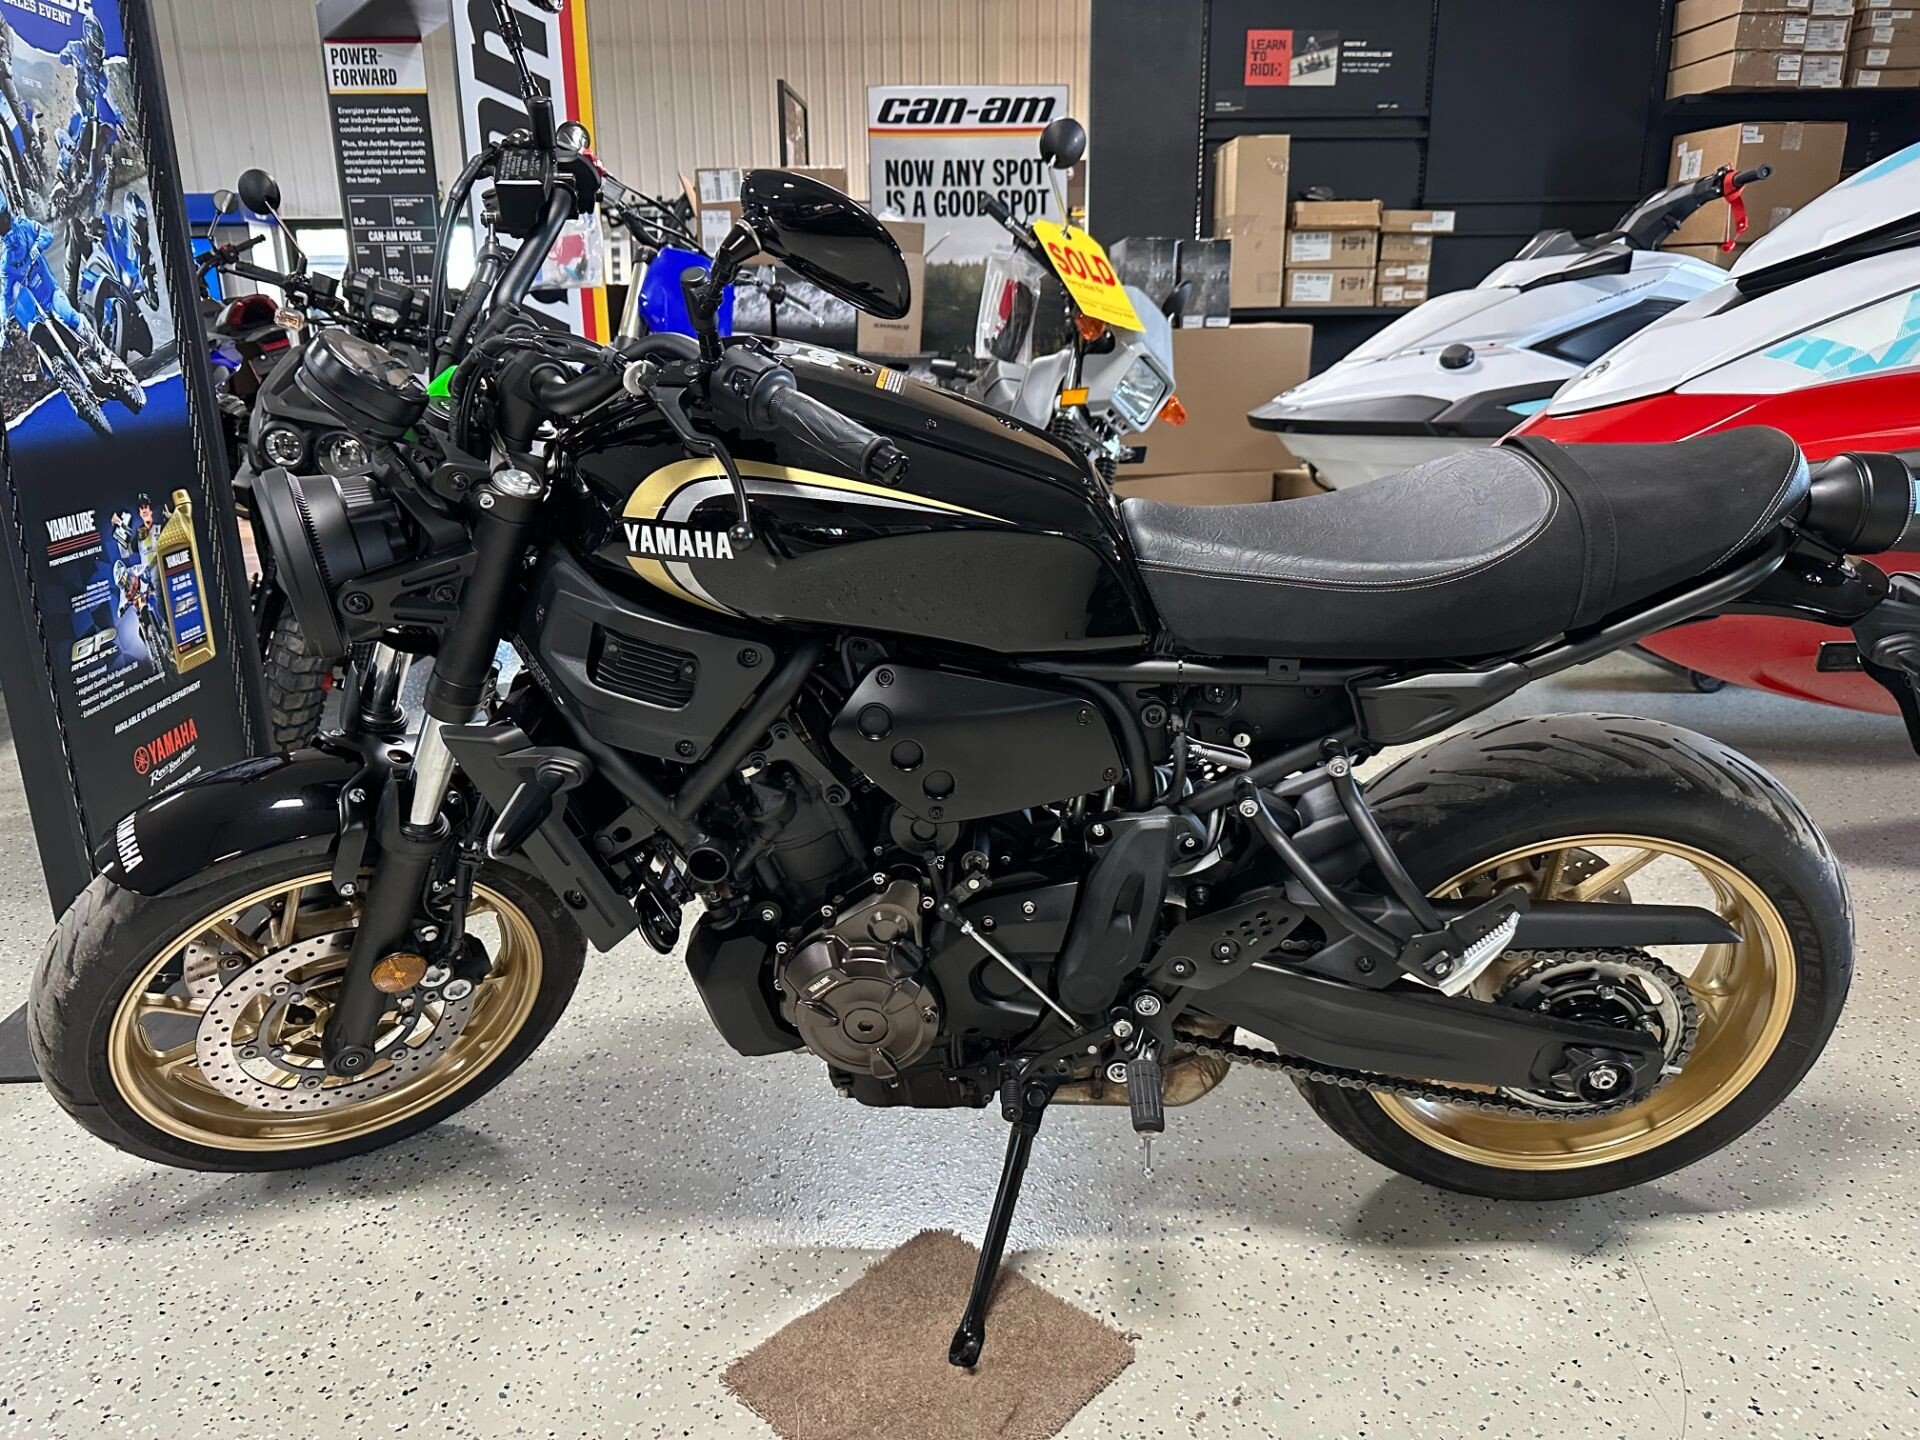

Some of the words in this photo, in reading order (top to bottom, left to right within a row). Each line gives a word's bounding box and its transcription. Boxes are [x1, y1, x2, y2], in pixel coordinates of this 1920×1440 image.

[38, 2, 72, 26] EVENT
[1251, 39, 1287, 50] LEARN
[330, 47, 383, 65] POWER-
[1251, 51, 1267, 62] TO
[332, 68, 397, 86] FORWARD
[1250, 62, 1282, 77] RIDE
[337, 106, 365, 115] Energize
[365, 107, 379, 115] your
[380, 106, 397, 114] rides
[397, 106, 412, 114] with
[877, 96, 1056, 124] can-am
[339, 125, 361, 133] cooled
[362, 125, 386, 134] charger
[387, 125, 399, 133] and
[342, 149, 365, 157] greater
[365, 148, 388, 156] control
[388, 148, 401, 156] and
[402, 148, 426, 156] smooth
[357, 139, 369, 147] the
[369, 139, 389, 147] Active
[410, 139, 425, 148] puts
[343, 157, 382, 165] deceleration
[404, 157, 424, 165] hands
[362, 167, 382, 175] giving
[398, 167, 418, 175] power
[885, 159, 934, 187] NOW
[942, 158, 985, 187] ANY
[993, 158, 1044, 186] SPOT
[886, 189, 905, 217] IS
[912, 190, 927, 217] A
[934, 189, 991, 218] GOOD
[997, 189, 1050, 216] SPOT
[368, 231, 398, 241] CAN-AM
[399, 230, 423, 241] PULSE
[1047, 242, 1116, 287] SOLD
[46, 510, 96, 542] YAMALUBE
[623, 522, 734, 560] YAMAHA
[71, 627, 117, 662] GP
[71, 654, 99, 673] RACING
[114, 712, 142, 735] AVAILABLE
[140, 709, 147, 720] IN
[147, 704, 157, 716] THE
[156, 696, 172, 711] PARTS
[171, 680, 201, 703] DEPARTMENT
[147, 718, 198, 765] YAMAHA
[148, 765, 170, 787] Revs
[116, 811, 144, 874] YAMAHA
